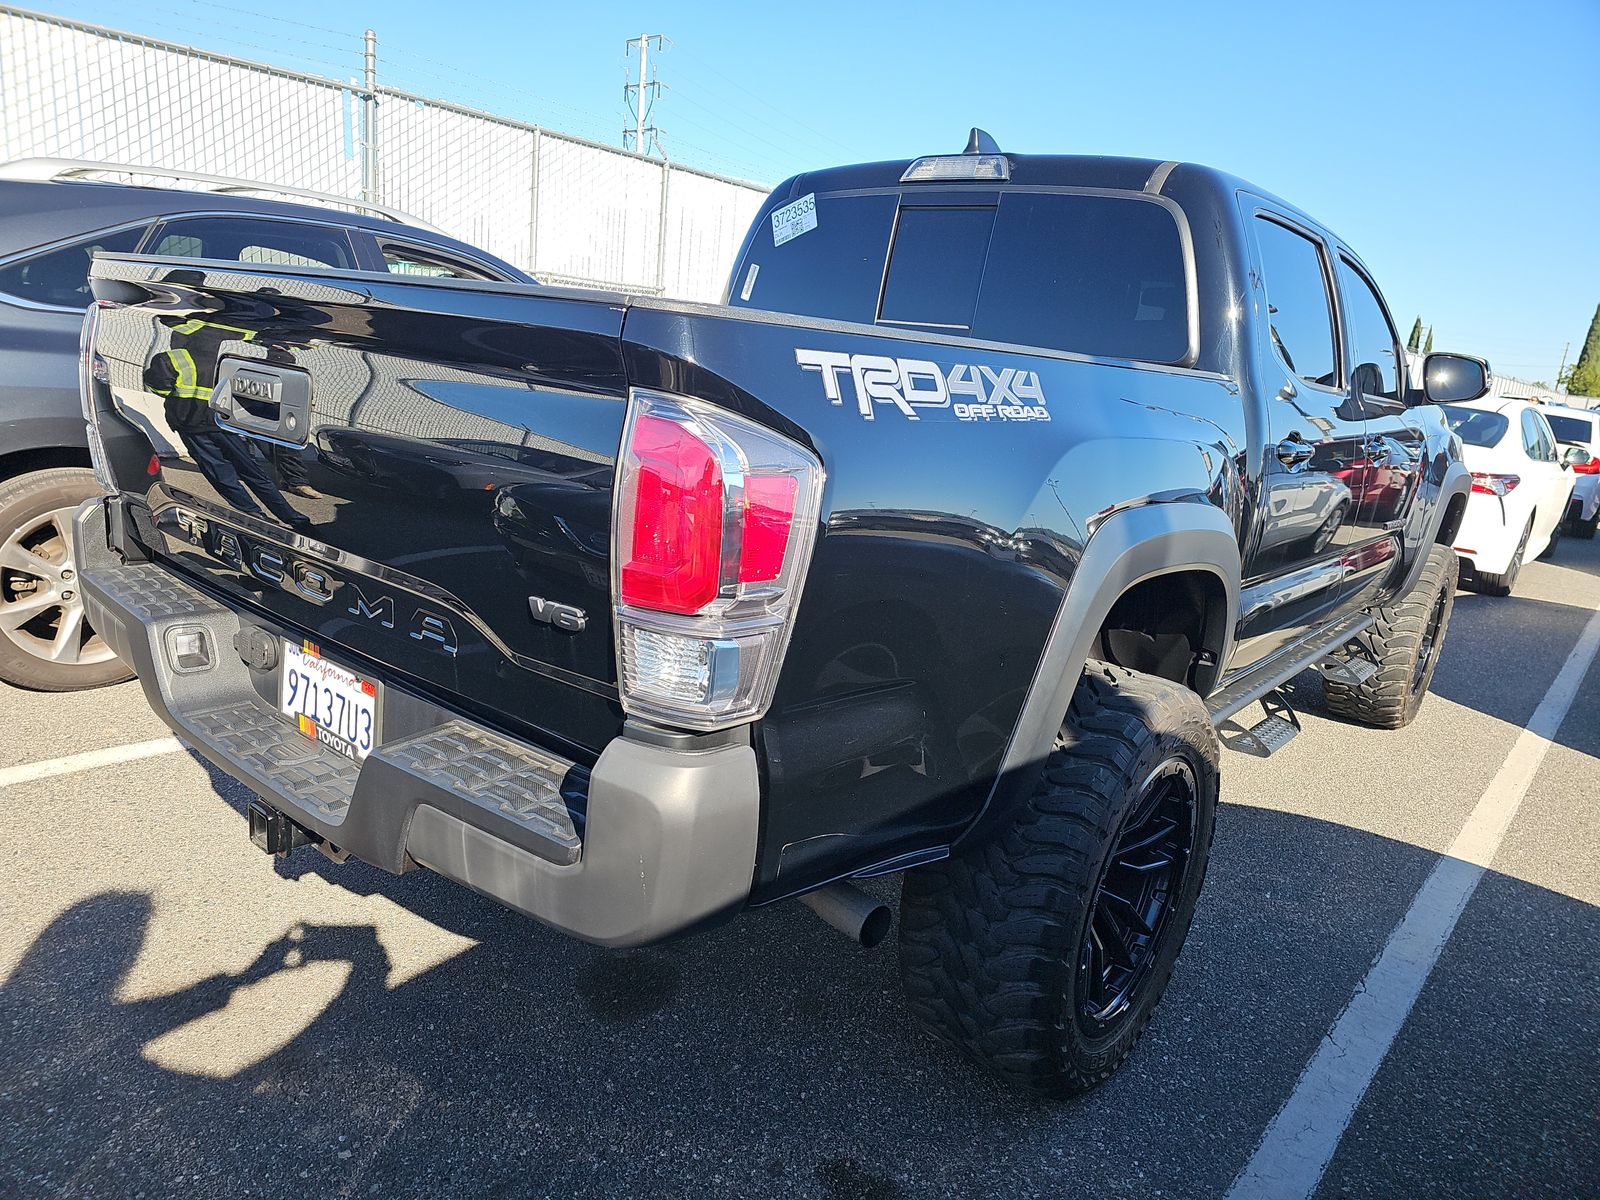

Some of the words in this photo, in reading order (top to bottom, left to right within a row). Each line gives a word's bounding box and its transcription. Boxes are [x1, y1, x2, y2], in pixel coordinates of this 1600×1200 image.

[773, 196, 816, 229] 3723535
[795, 348, 950, 421] TRD
[953, 403, 997, 420] OFF
[997, 404, 1051, 421] ROAD
[176, 507, 459, 656] TACOMA
[528, 596, 589, 632] V6
[302, 652, 362, 694] California
[287, 668, 372, 750] 97137U3
[316, 726, 354, 759] TOYOTA
